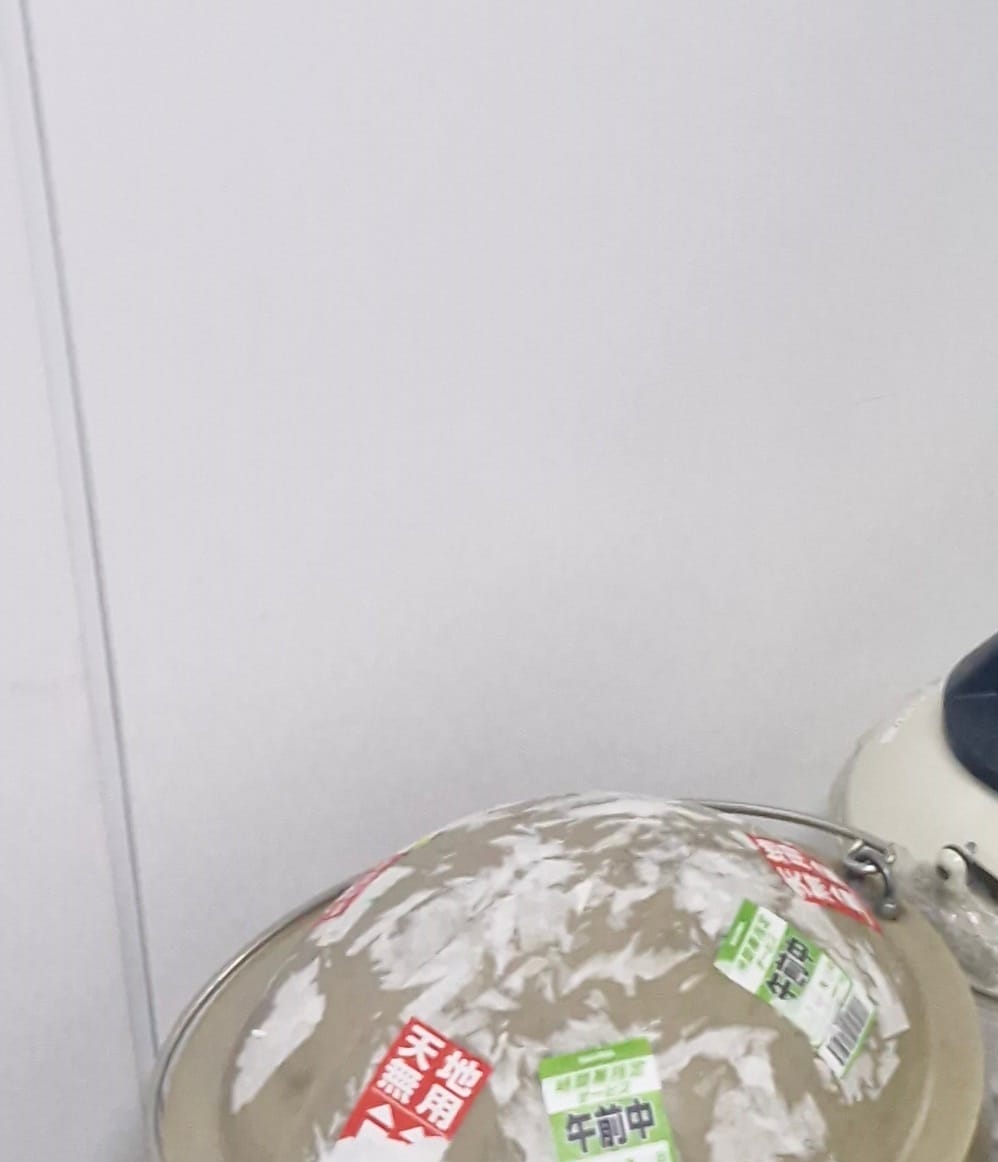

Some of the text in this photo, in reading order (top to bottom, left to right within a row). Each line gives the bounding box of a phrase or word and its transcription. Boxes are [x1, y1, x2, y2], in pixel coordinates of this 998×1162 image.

[376, 1057, 464, 1131] 無用
[397, 1024, 483, 1098] 天地
[565, 1098, 655, 1153] 午前中
